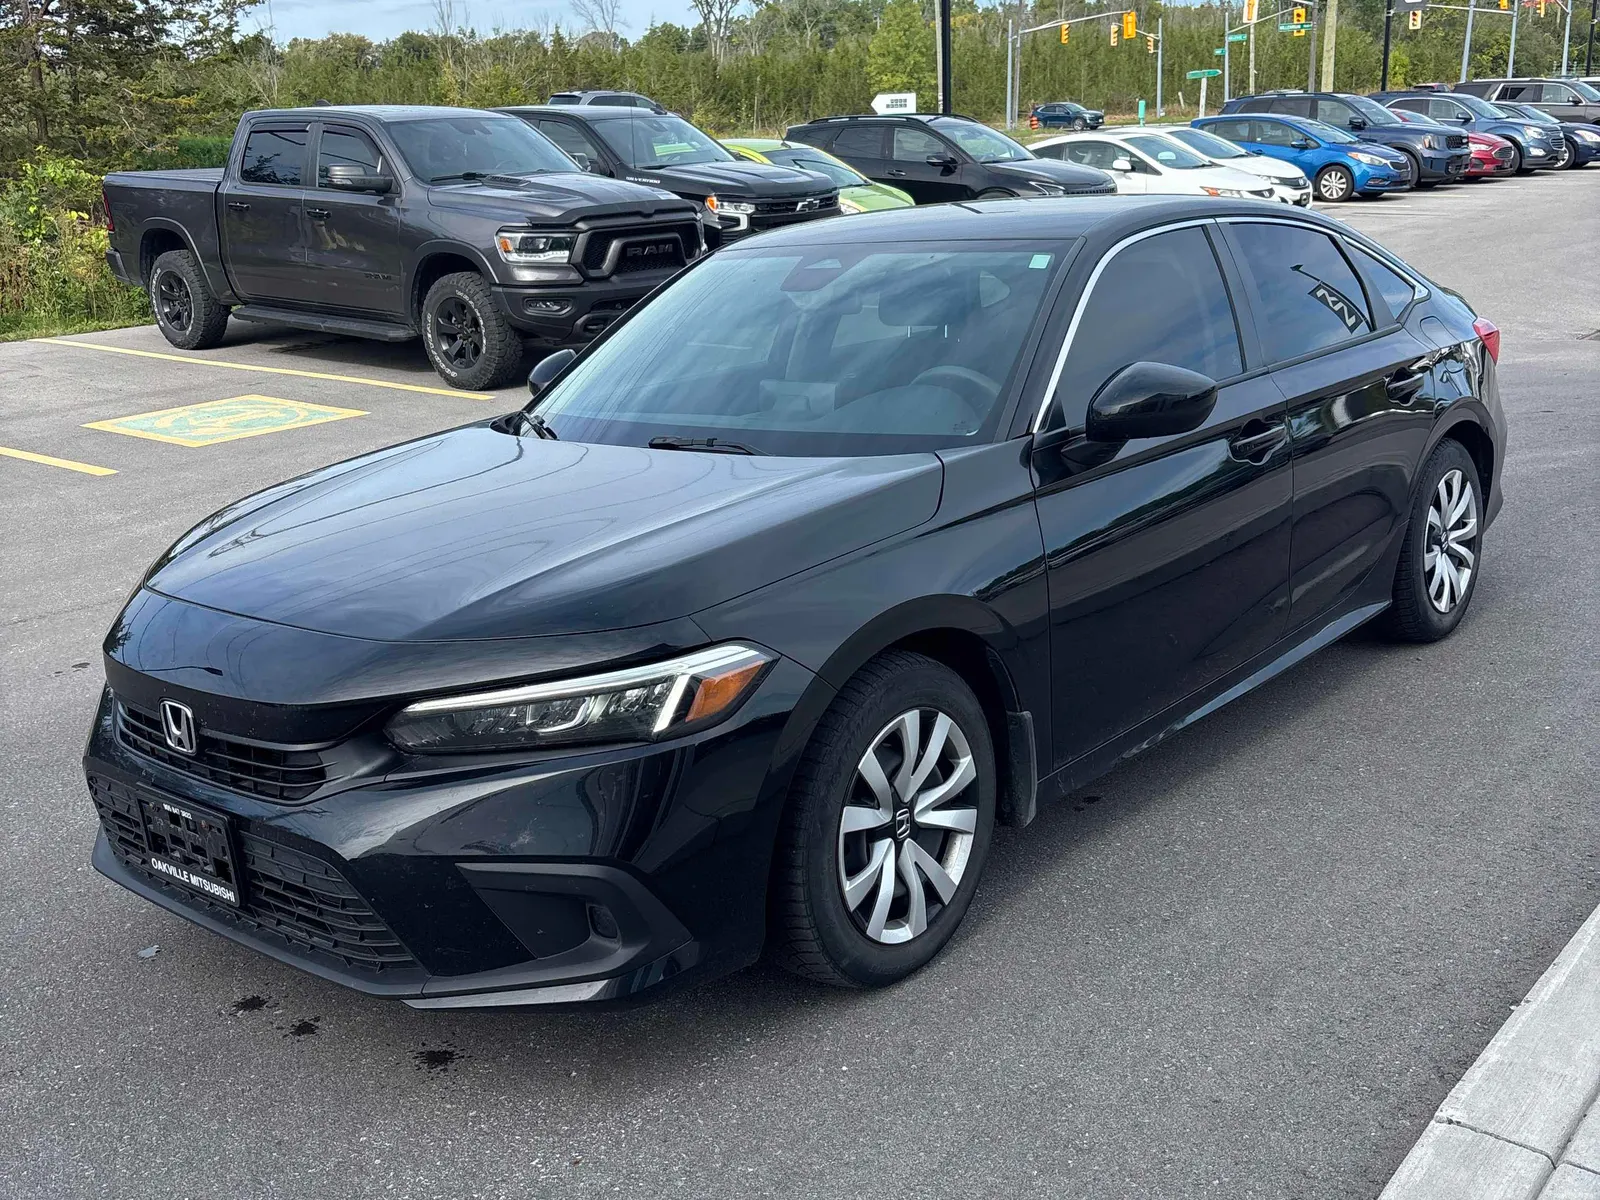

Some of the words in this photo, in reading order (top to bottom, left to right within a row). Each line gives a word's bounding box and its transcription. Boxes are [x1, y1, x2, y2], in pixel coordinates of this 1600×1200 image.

[626, 243, 673, 257] RAM
[426, 312, 458, 378] GOODYEAR
[151, 857, 190, 883] OAKVILLE
[189, 873, 236, 903] MITSUBISHI
